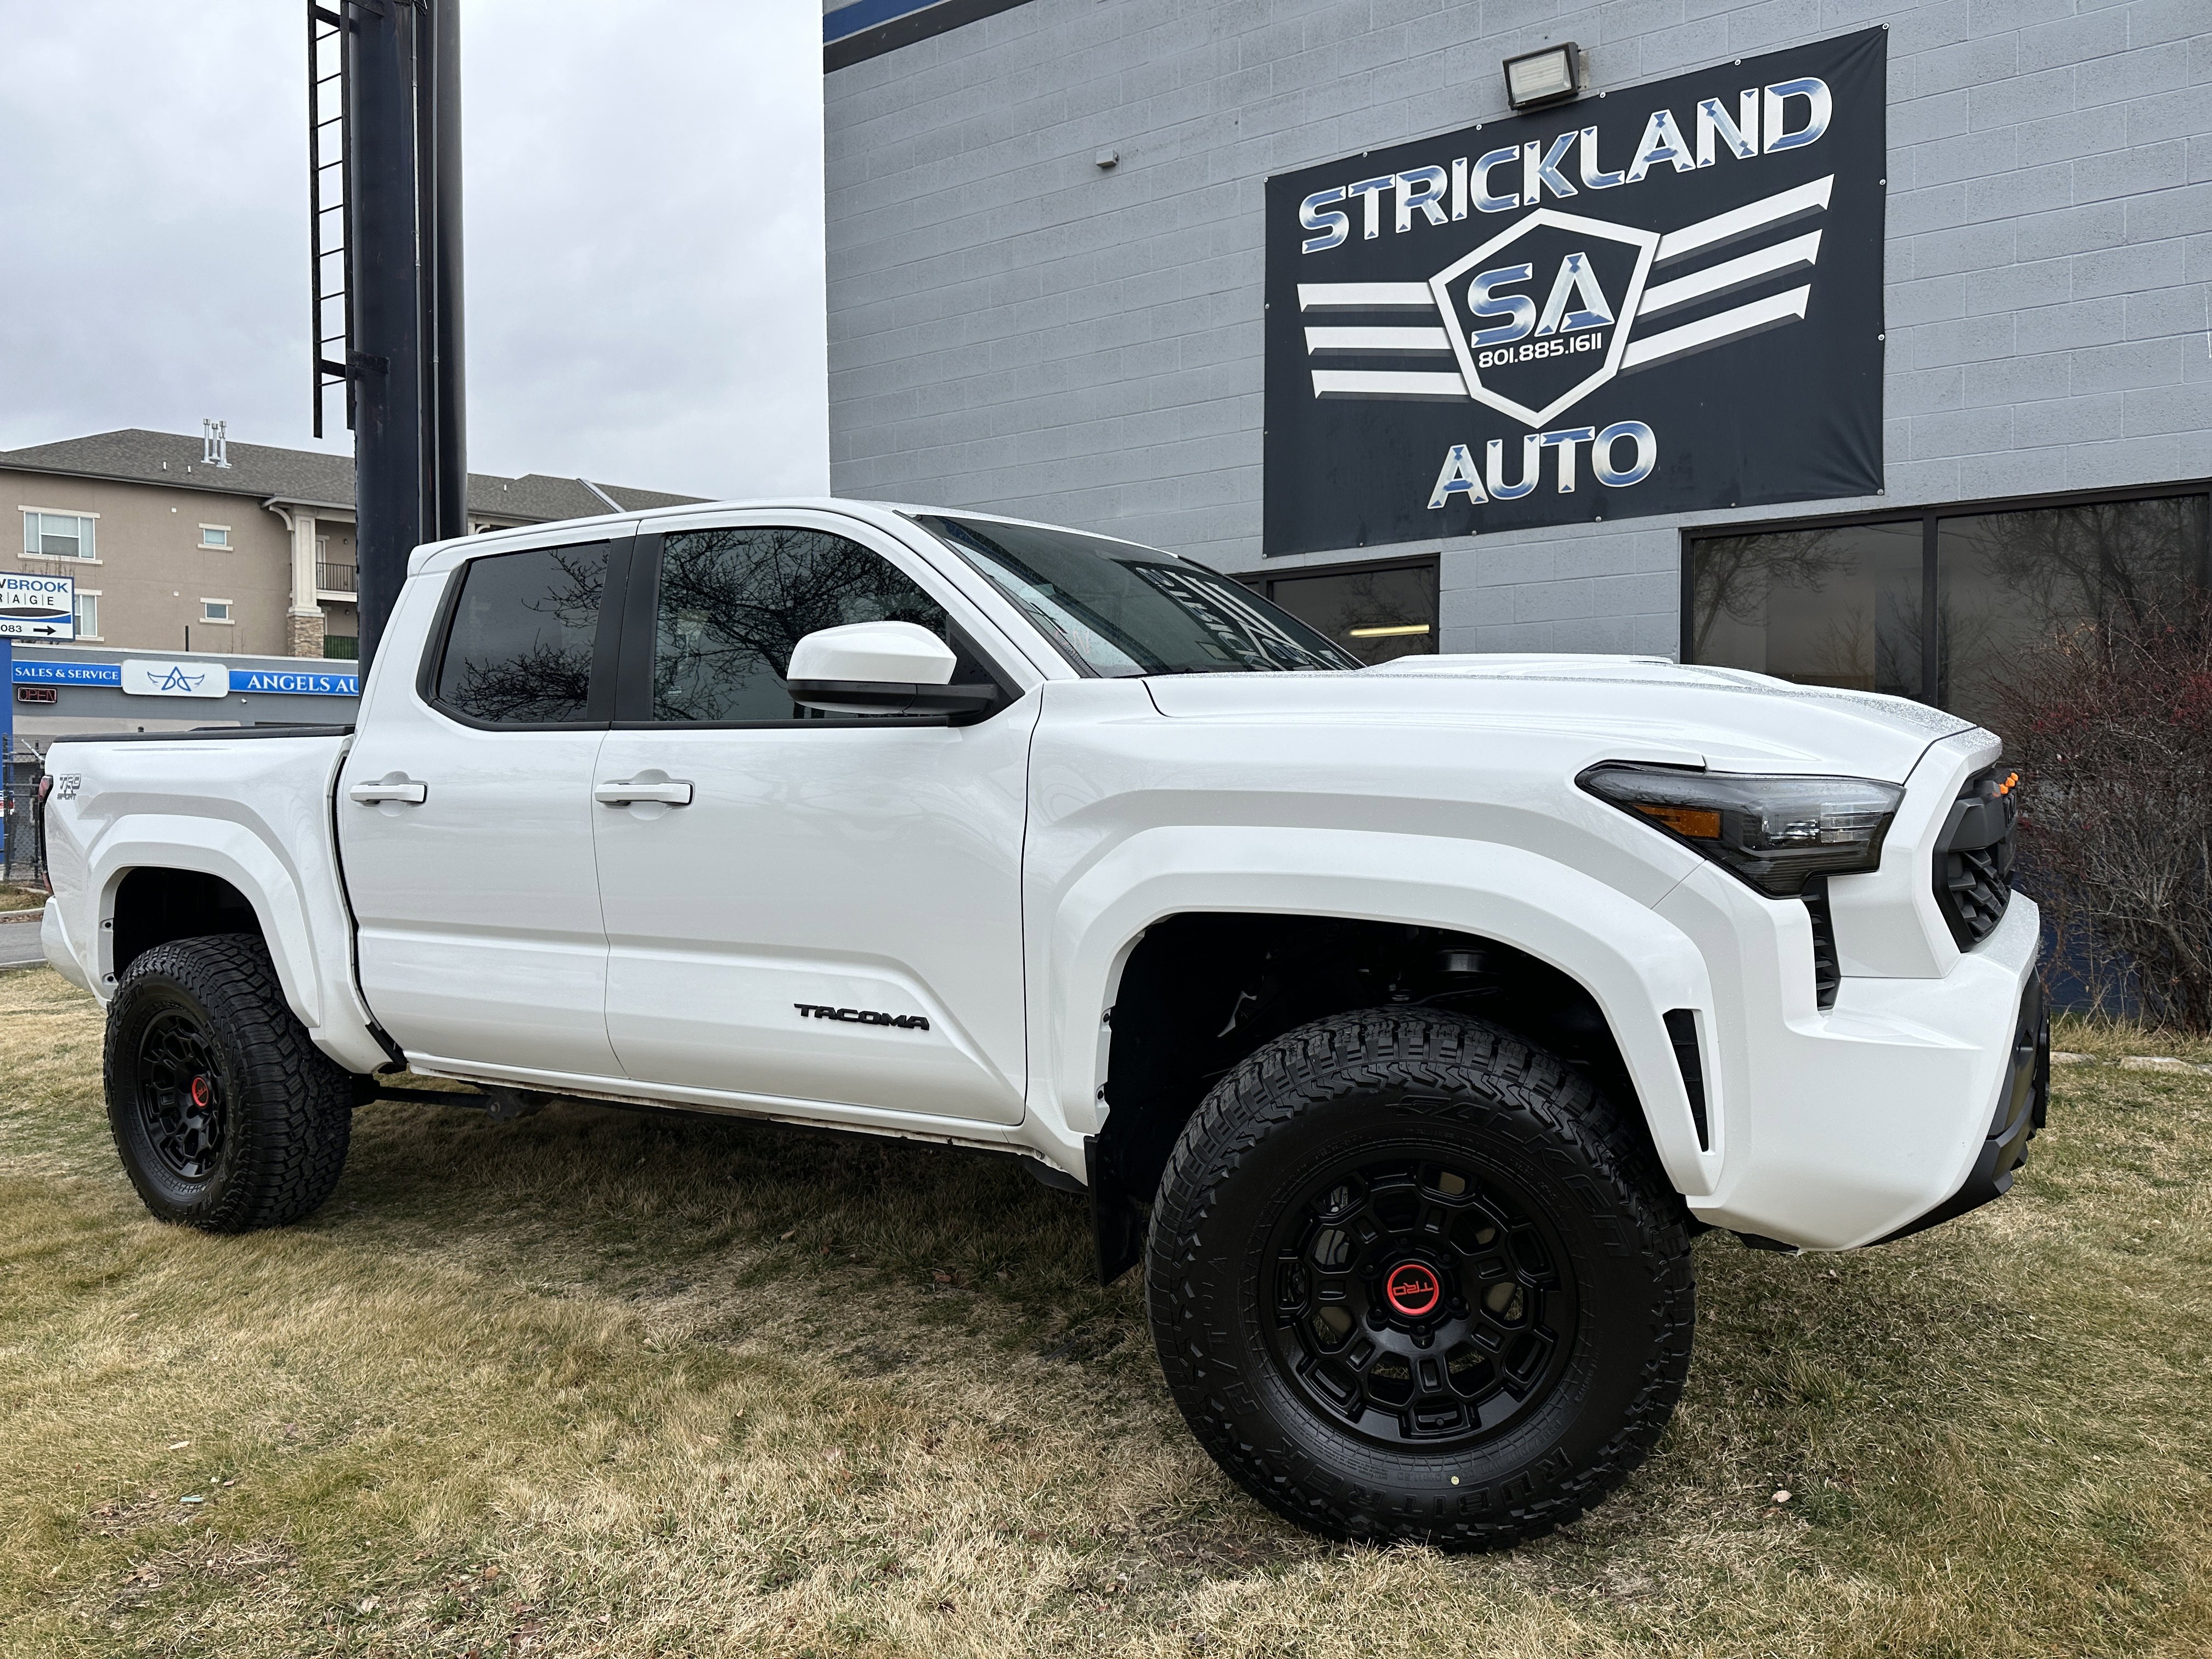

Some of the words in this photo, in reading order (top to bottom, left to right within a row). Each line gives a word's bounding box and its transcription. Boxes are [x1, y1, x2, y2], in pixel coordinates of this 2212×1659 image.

[1298, 76, 1833, 254] STRICKLAND
[1466, 251, 1615, 348] SA
[1477, 331, 1602, 369] 801.885.1611
[1427, 420, 1657, 510] AUTO
[15, 667, 53, 677] SALES
[55, 669, 65, 678] &
[68, 669, 119, 680] SERVICE
[247, 674, 330, 691] ANGELS
[19, 689, 55, 701] OPEN
[794, 1003, 929, 1031] TACOMA
[1392, 1280, 1434, 1296] TRD
